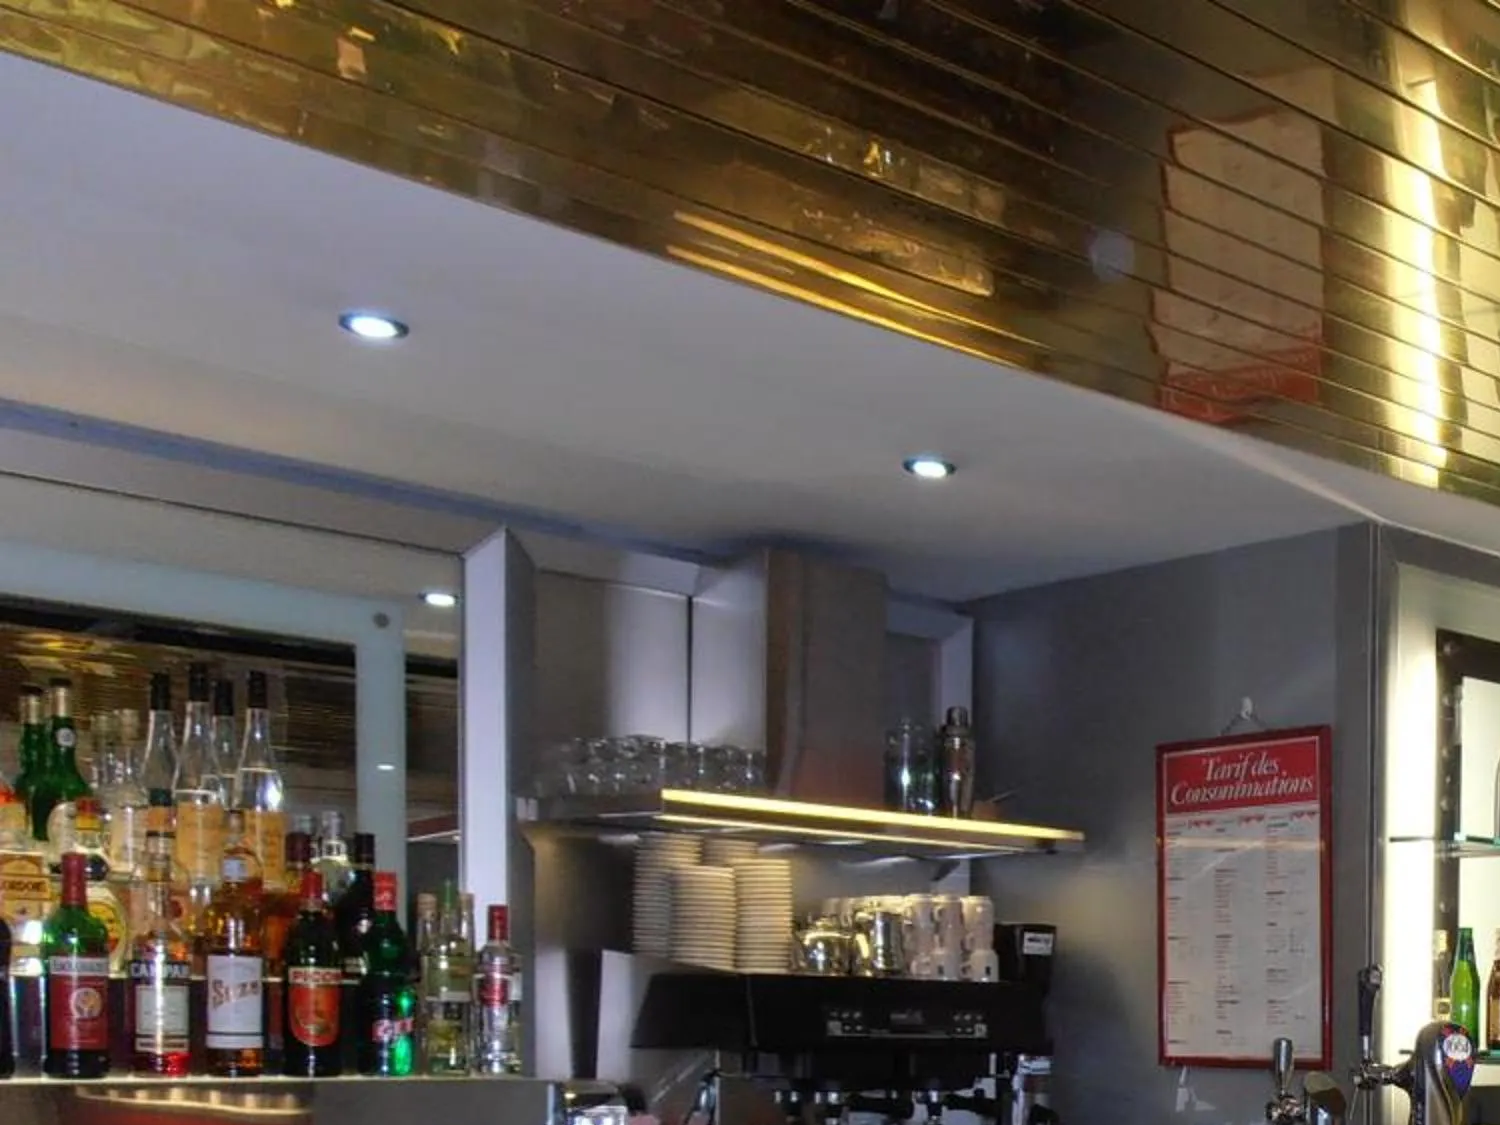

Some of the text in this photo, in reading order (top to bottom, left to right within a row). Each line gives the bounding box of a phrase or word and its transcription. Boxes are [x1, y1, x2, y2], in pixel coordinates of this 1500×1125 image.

[1201, 751, 1280, 782] Tarif des
[1170, 772, 1314, 805] Consommations
